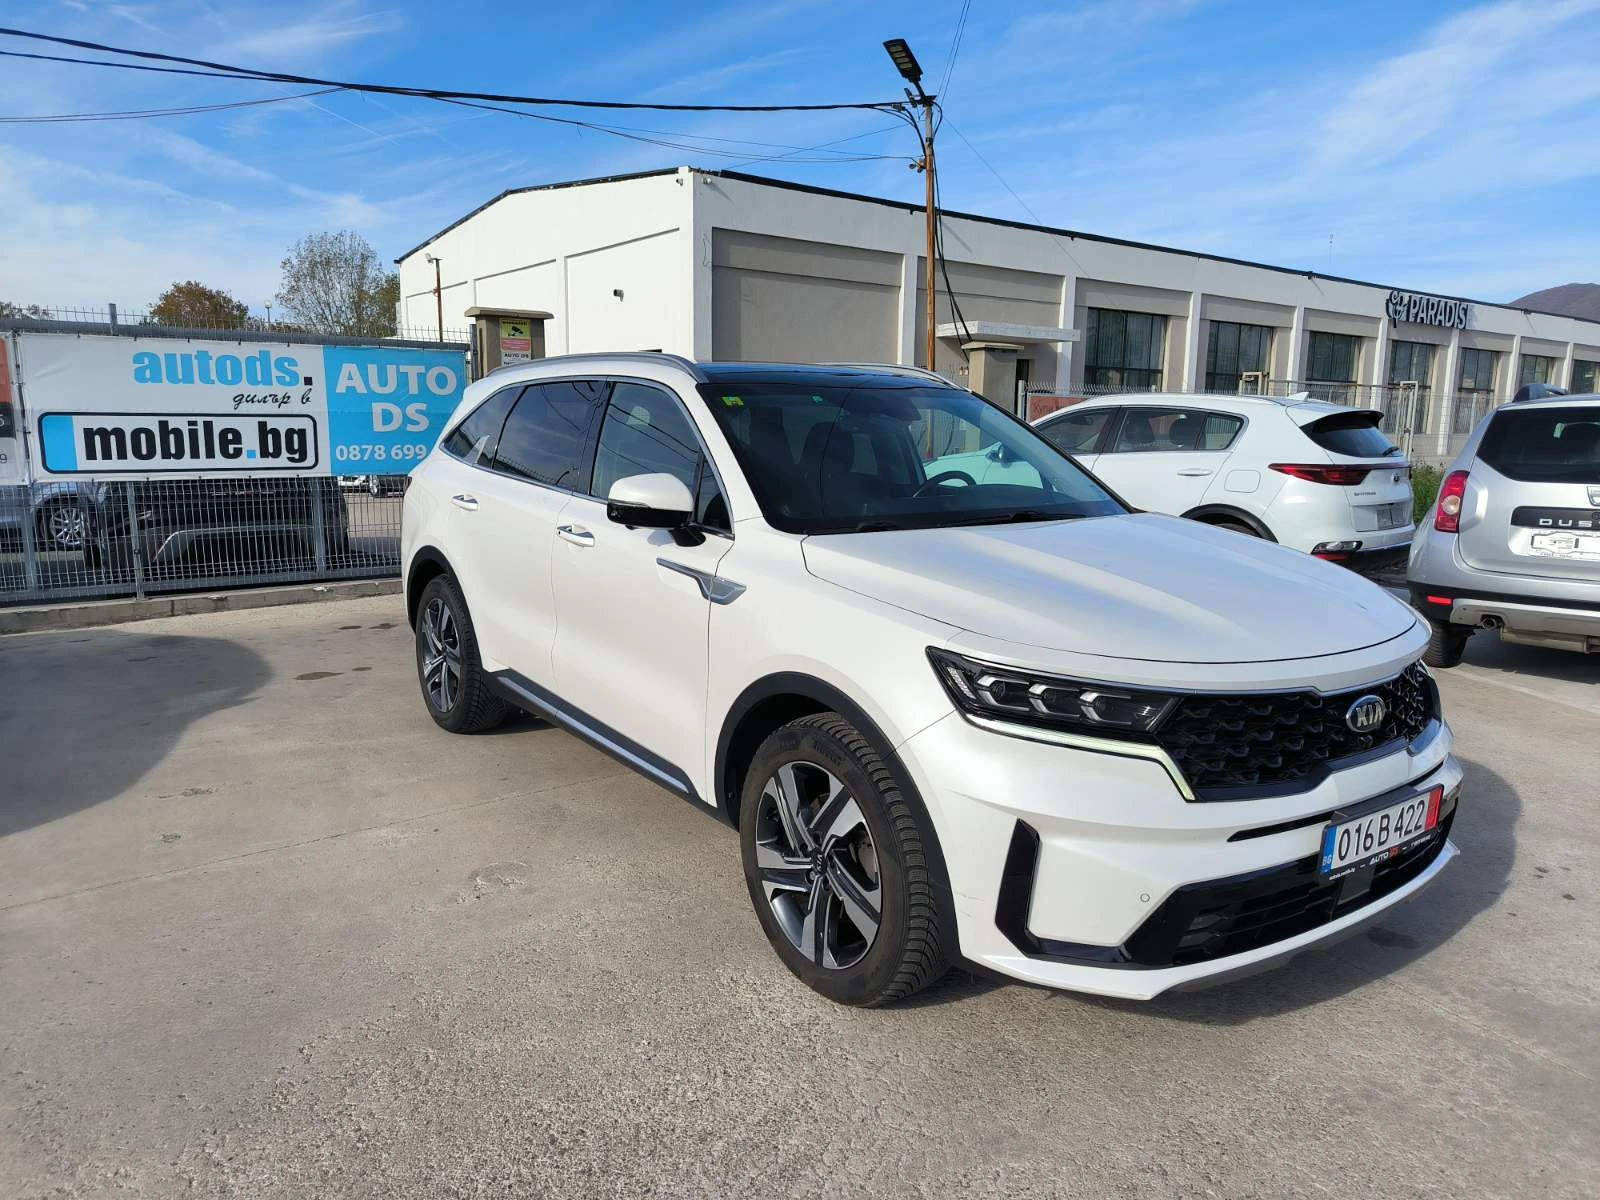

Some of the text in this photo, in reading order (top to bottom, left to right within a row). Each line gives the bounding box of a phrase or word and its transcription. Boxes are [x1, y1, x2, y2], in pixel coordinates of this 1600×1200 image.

[335, 363, 457, 396] AUTO
[232, 392, 291, 410] дилър
[371, 402, 430, 433] DS
[83, 420, 308, 463] mobile.bg
[335, 444, 428, 461] 0878 699
[1538, 518, 1600, 528] DUS
[1356, 701, 1382, 728] KIA
[1369, 851, 1389, 865] AUTO
